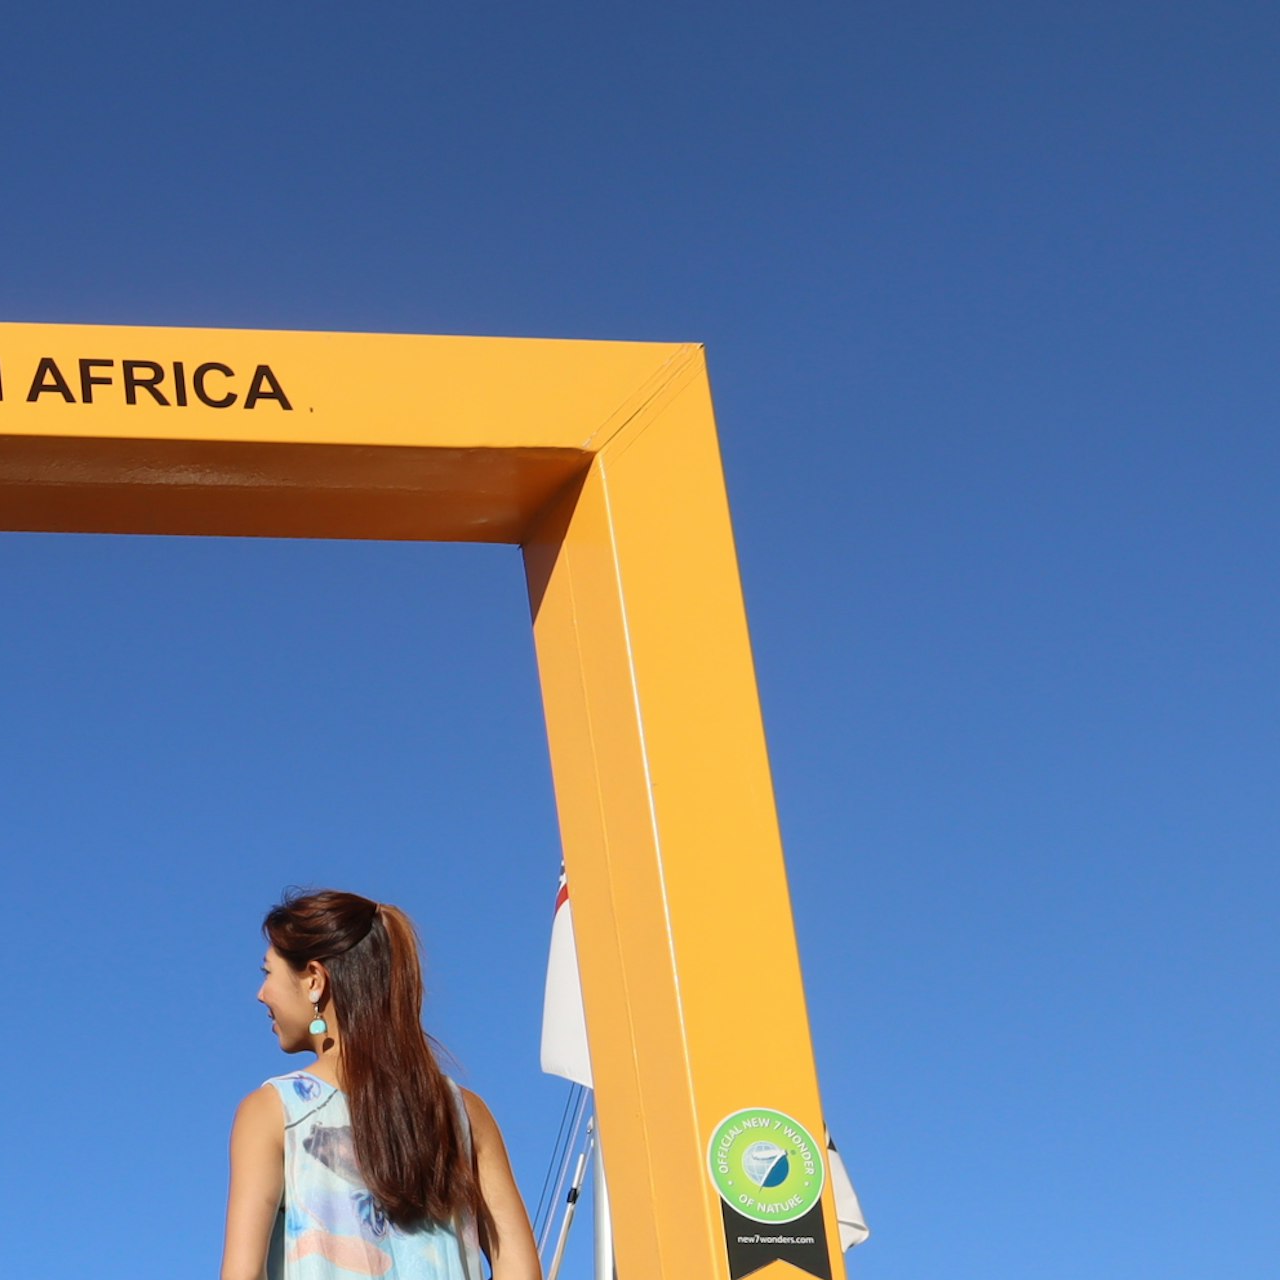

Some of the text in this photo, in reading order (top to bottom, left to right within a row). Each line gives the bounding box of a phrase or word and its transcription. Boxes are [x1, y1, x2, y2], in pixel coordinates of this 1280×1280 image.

[26, 357, 293, 411] AFRICA
[718, 1117, 815, 1176] OFFICIAL NEW 7 WONDER
[738, 1193, 804, 1214] OF NATURE
[737, 1234, 815, 1244] new7wonders.com
